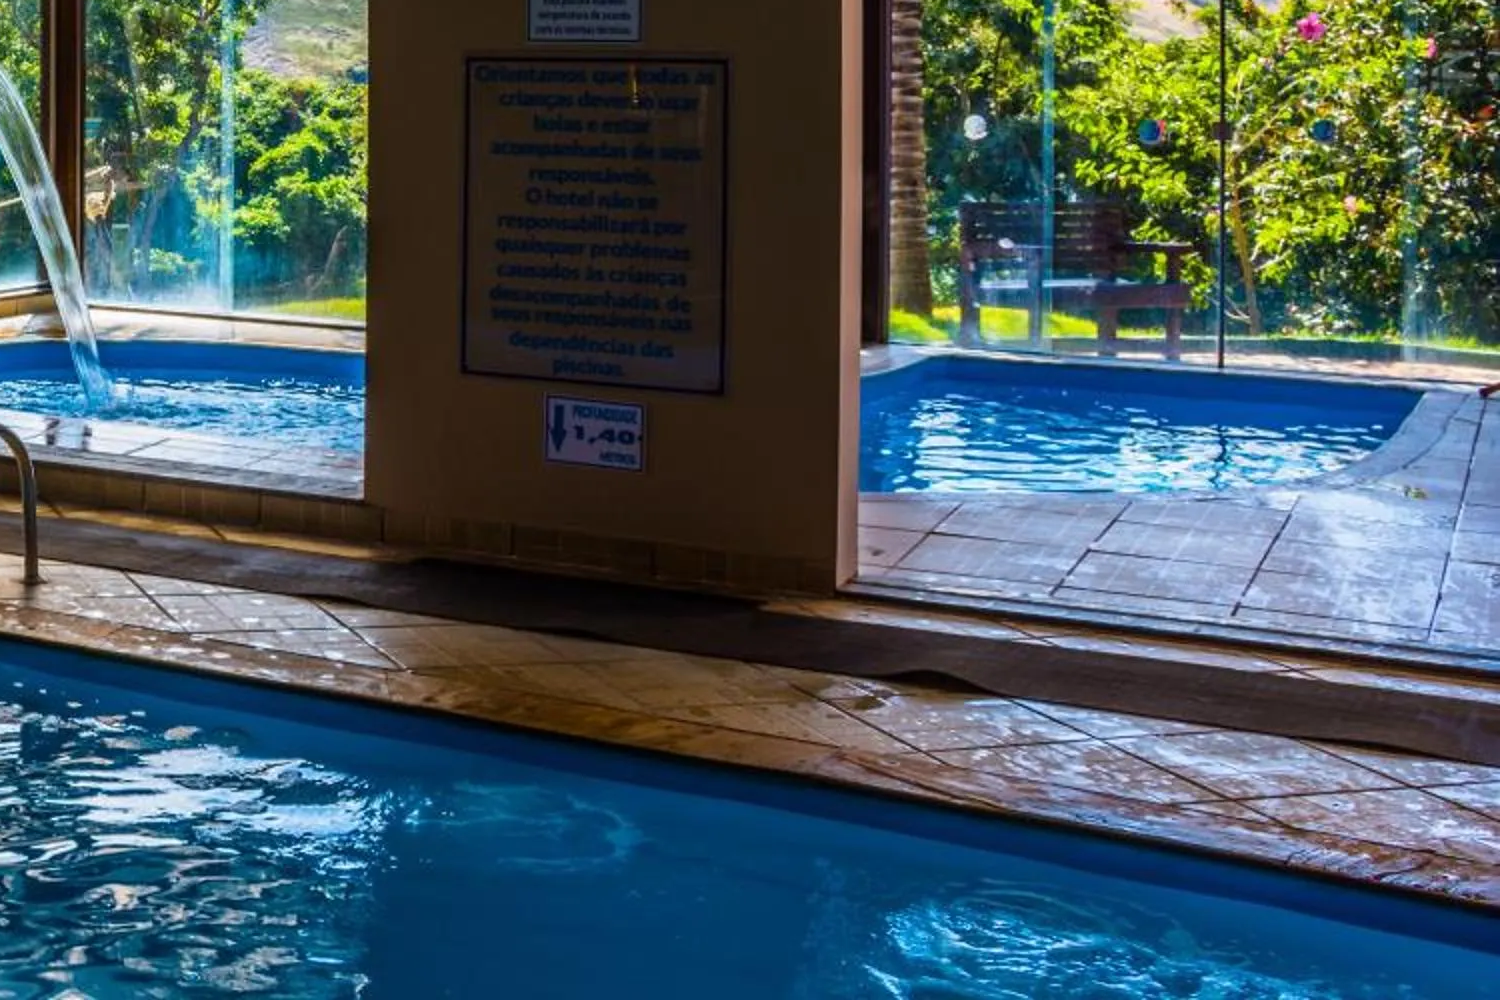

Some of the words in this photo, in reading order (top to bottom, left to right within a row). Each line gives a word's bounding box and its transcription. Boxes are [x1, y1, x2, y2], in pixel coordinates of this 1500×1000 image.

[475, 65, 586, 82] Orientamos
[592, 69, 628, 85] que
[526, 186, 542, 205] O
[546, 188, 594, 206] hotel
[573, 425, 635, 445] 1,40
